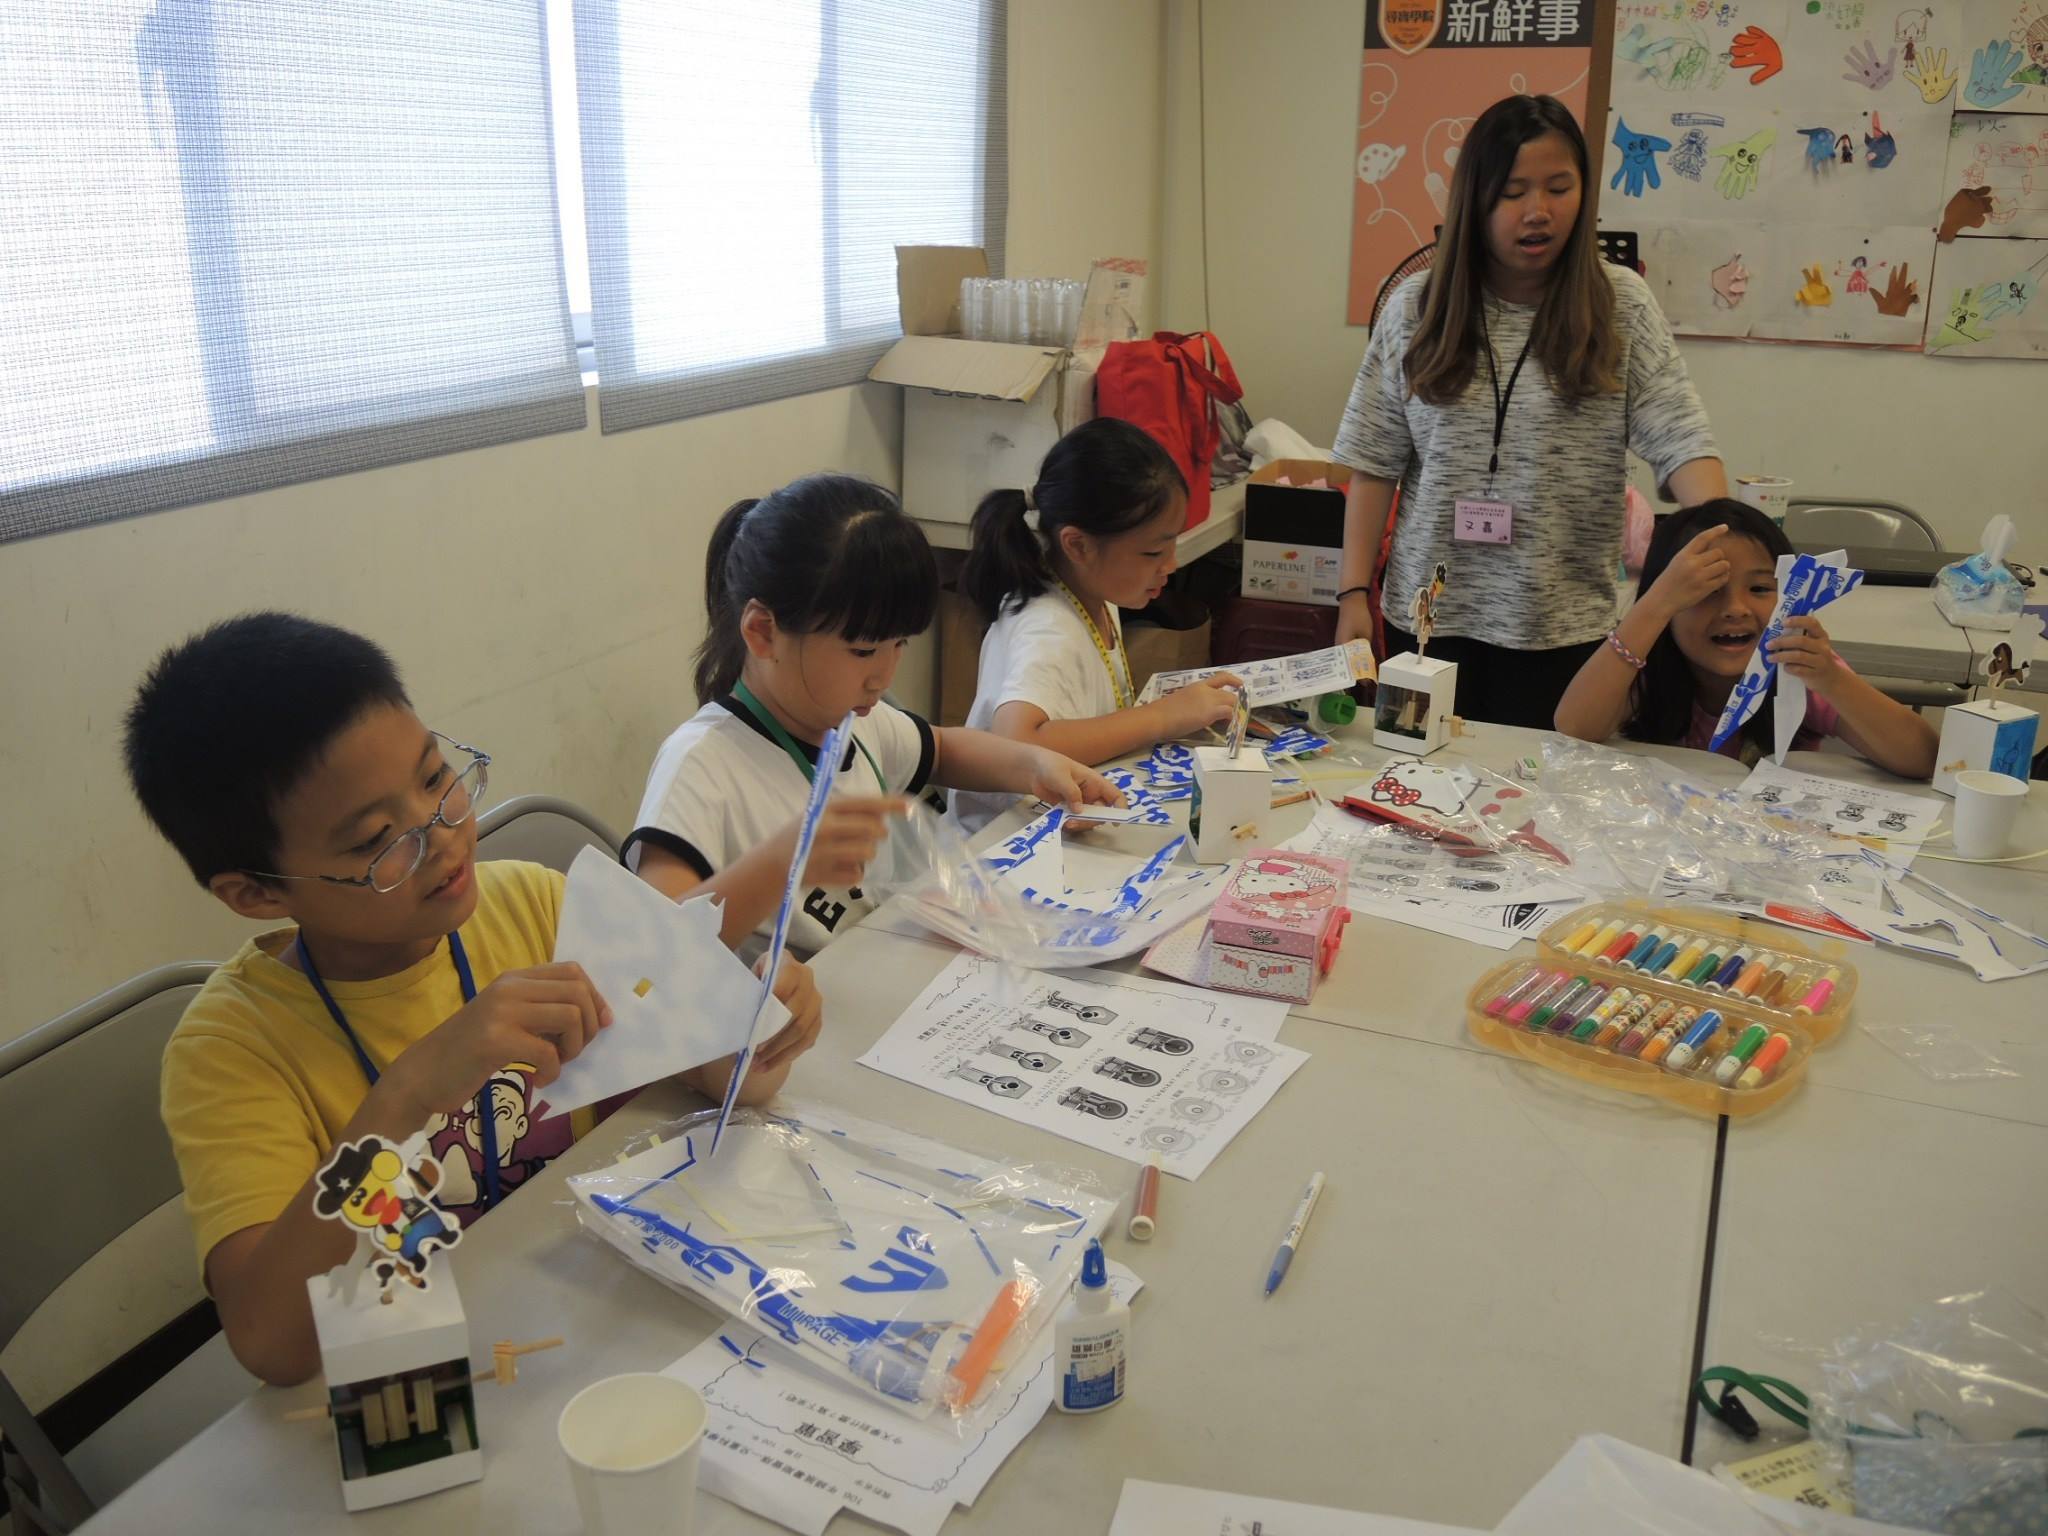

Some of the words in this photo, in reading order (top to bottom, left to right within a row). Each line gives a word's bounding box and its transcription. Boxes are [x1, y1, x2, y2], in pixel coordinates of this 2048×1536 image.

[1446, 0, 1581, 42] 新鮮事
[1252, 559, 1307, 573] PAPERLINE
[794, 1422, 863, 1456] 學習單
